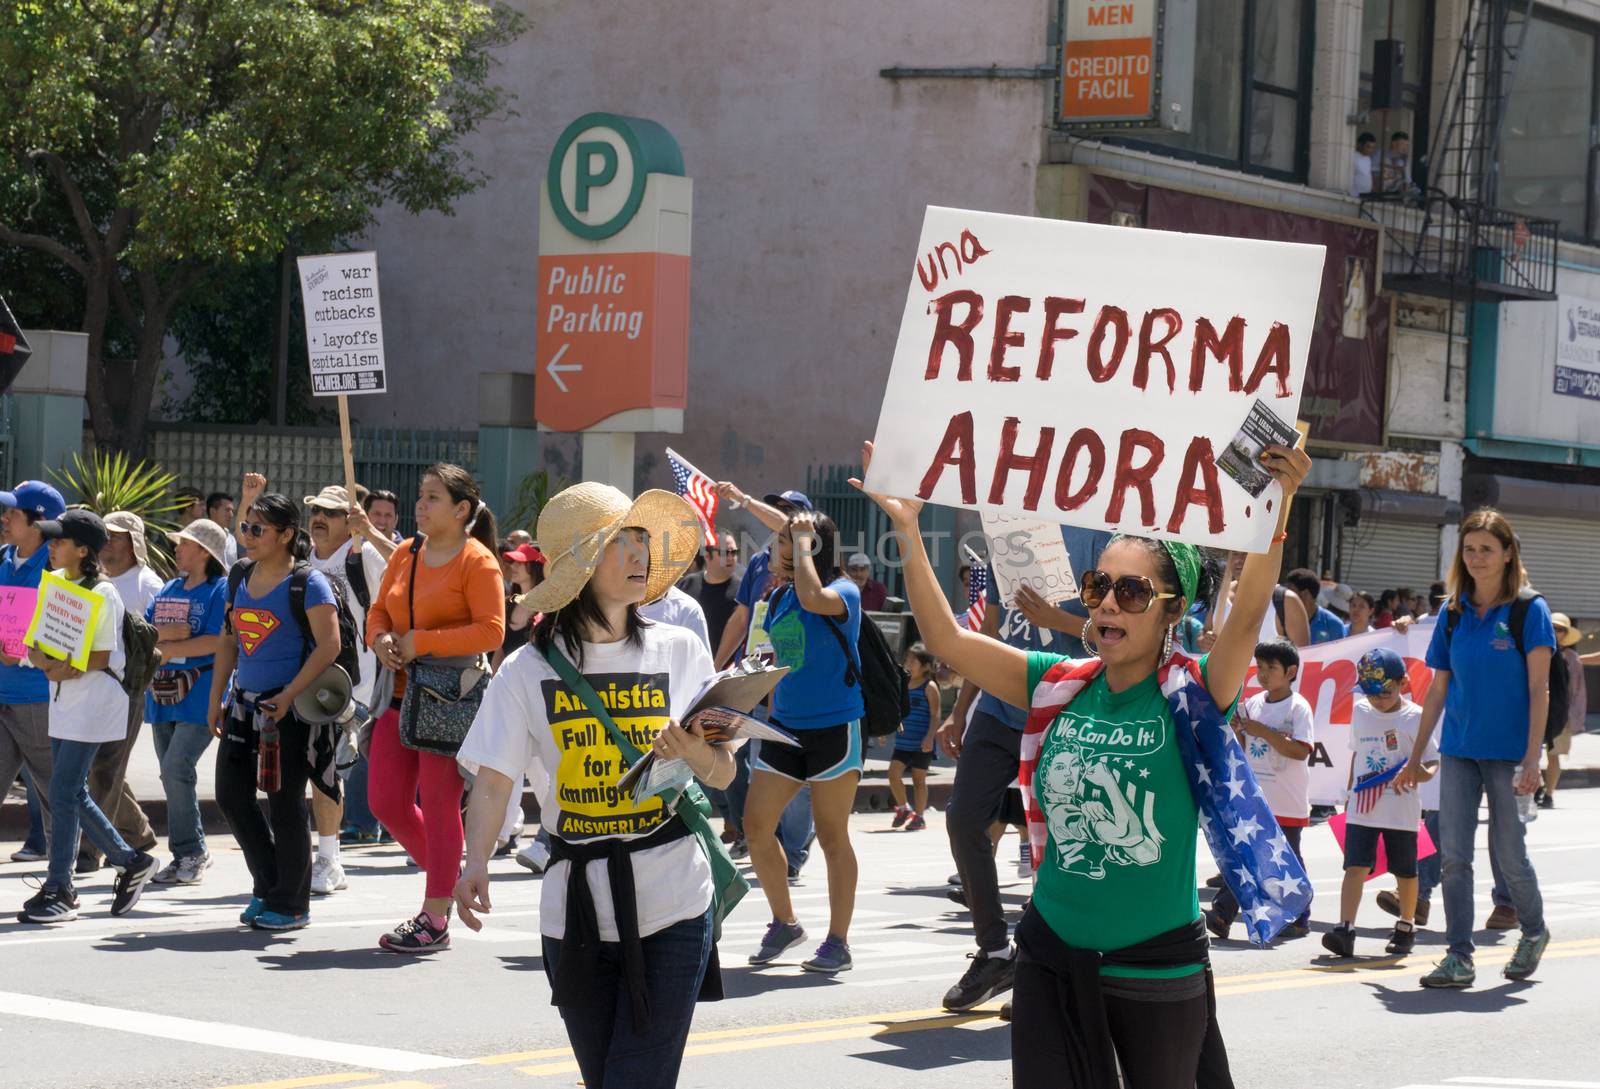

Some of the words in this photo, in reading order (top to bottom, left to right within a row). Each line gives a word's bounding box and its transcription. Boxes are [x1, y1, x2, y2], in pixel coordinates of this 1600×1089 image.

[1088, 4, 1134, 26] MEN
[1066, 55, 1149, 78] CREDITO
[1078, 79, 1135, 99] FACIL
[575, 141, 618, 212] P
[916, 227, 993, 292] una
[341, 266, 372, 280] war
[547, 265, 626, 295] Public
[322, 286, 374, 302] racism
[314, 305, 376, 322] cutbacks
[546, 303, 644, 340] Parking
[323, 330, 378, 349] layoffs
[924, 289, 1293, 399] REFORMA
[311, 353, 379, 371] capitalism
[562, 724, 597, 750] Full
[1055, 717, 1078, 738] We
[1079, 722, 1107, 745] Can
[1108, 727, 1133, 746] Do
[1136, 727, 1156, 747] It!
[584, 755, 612, 777] for
